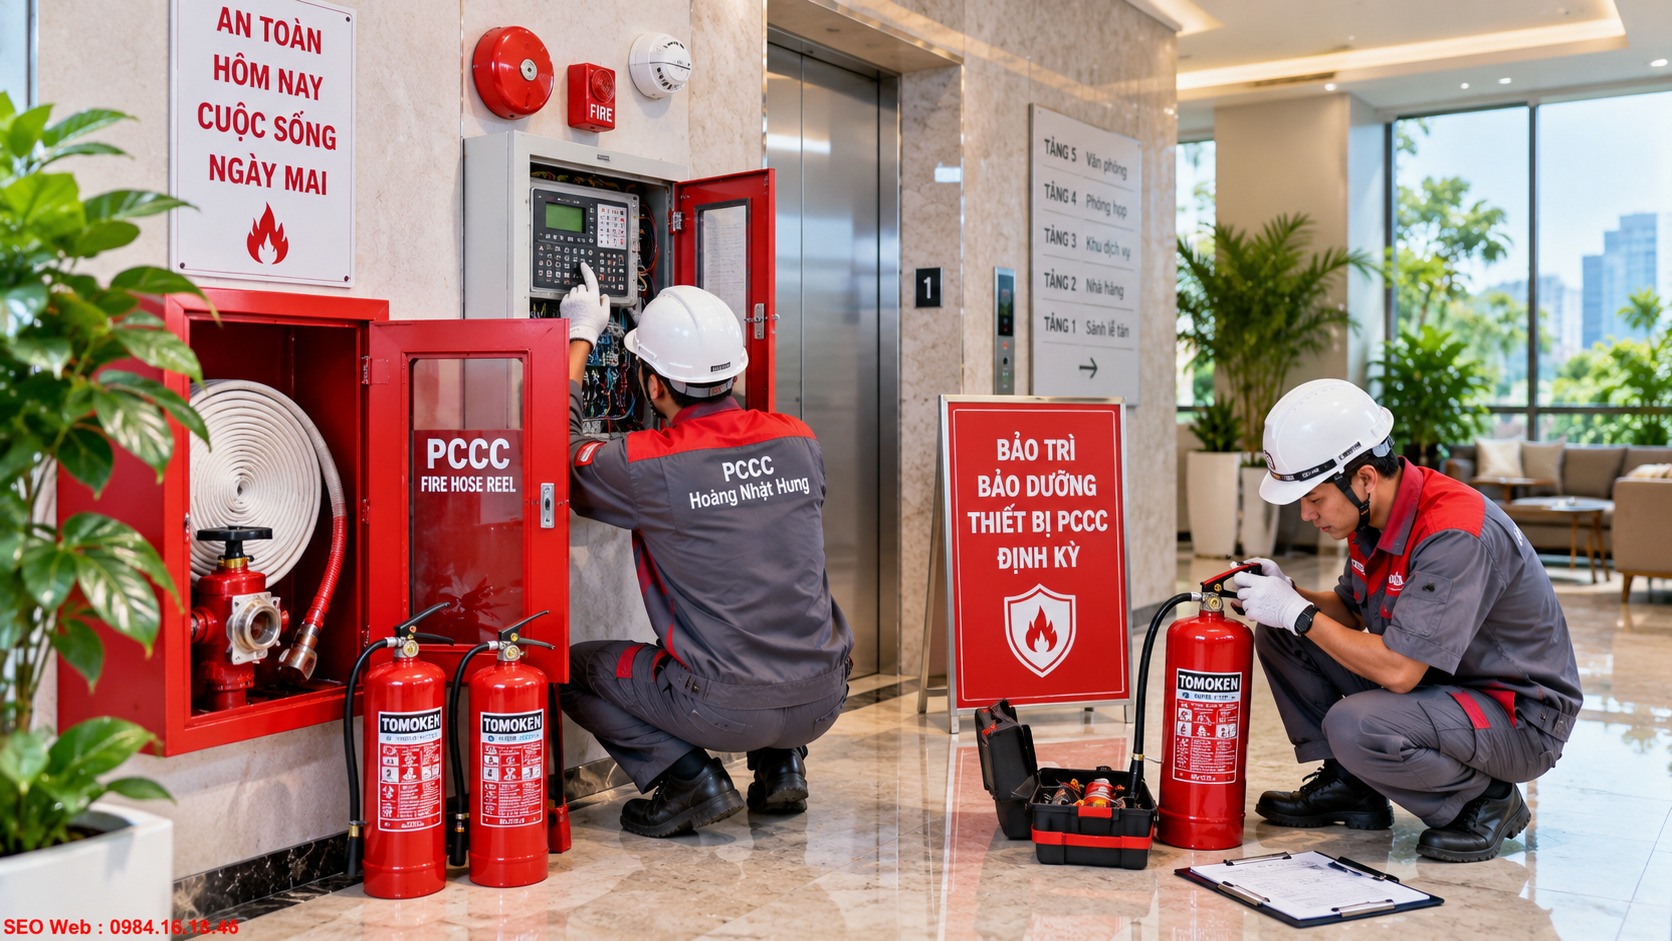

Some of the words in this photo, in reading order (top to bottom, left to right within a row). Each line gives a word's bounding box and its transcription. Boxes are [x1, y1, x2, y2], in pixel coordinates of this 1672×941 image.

[216, 6, 251, 38] AN
[259, 16, 322, 55] TOÀN
[213, 52, 270, 91] HÔM
[278, 67, 324, 101] NAY
[590, 103, 613, 123] FIRE
[197, 101, 266, 142] CUỘC
[273, 110, 337, 151] SỐNG
[1071, 146, 1077, 163] 5
[209, 152, 277, 188] NGÀY
[284, 165, 327, 196] MAI
[1071, 190, 1077, 207] 4
[1071, 232, 1077, 249] 3
[1086, 235, 1102, 254] Khu
[923, 276, 931, 299] 1
[1071, 276, 1077, 292] 2
[1071, 319, 1076, 334] 1
[427, 437, 511, 470] PCCC
[996, 431, 1039, 461] BẢO
[1044, 433, 1076, 461] TRÌ
[721, 455, 775, 482] PCCC
[421, 475, 448, 493] FIRE
[451, 475, 484, 493] HOSE
[486, 475, 517, 493] REEL
[776, 477, 810, 495] Hung
[977, 468, 1020, 497] BẢO
[1026, 469, 1097, 497] DƯỠNG
[967, 503, 1026, 534] THIẾT
[1031, 510, 1051, 538] BỊ
[1057, 509, 1109, 533] PCCC
[997, 546, 1048, 574] ĐỊNH
[1054, 540, 1080, 568] KỲ
[1179, 674, 1239, 691] TOMOKEN
[483, 714, 542, 733] TOMOKEN
